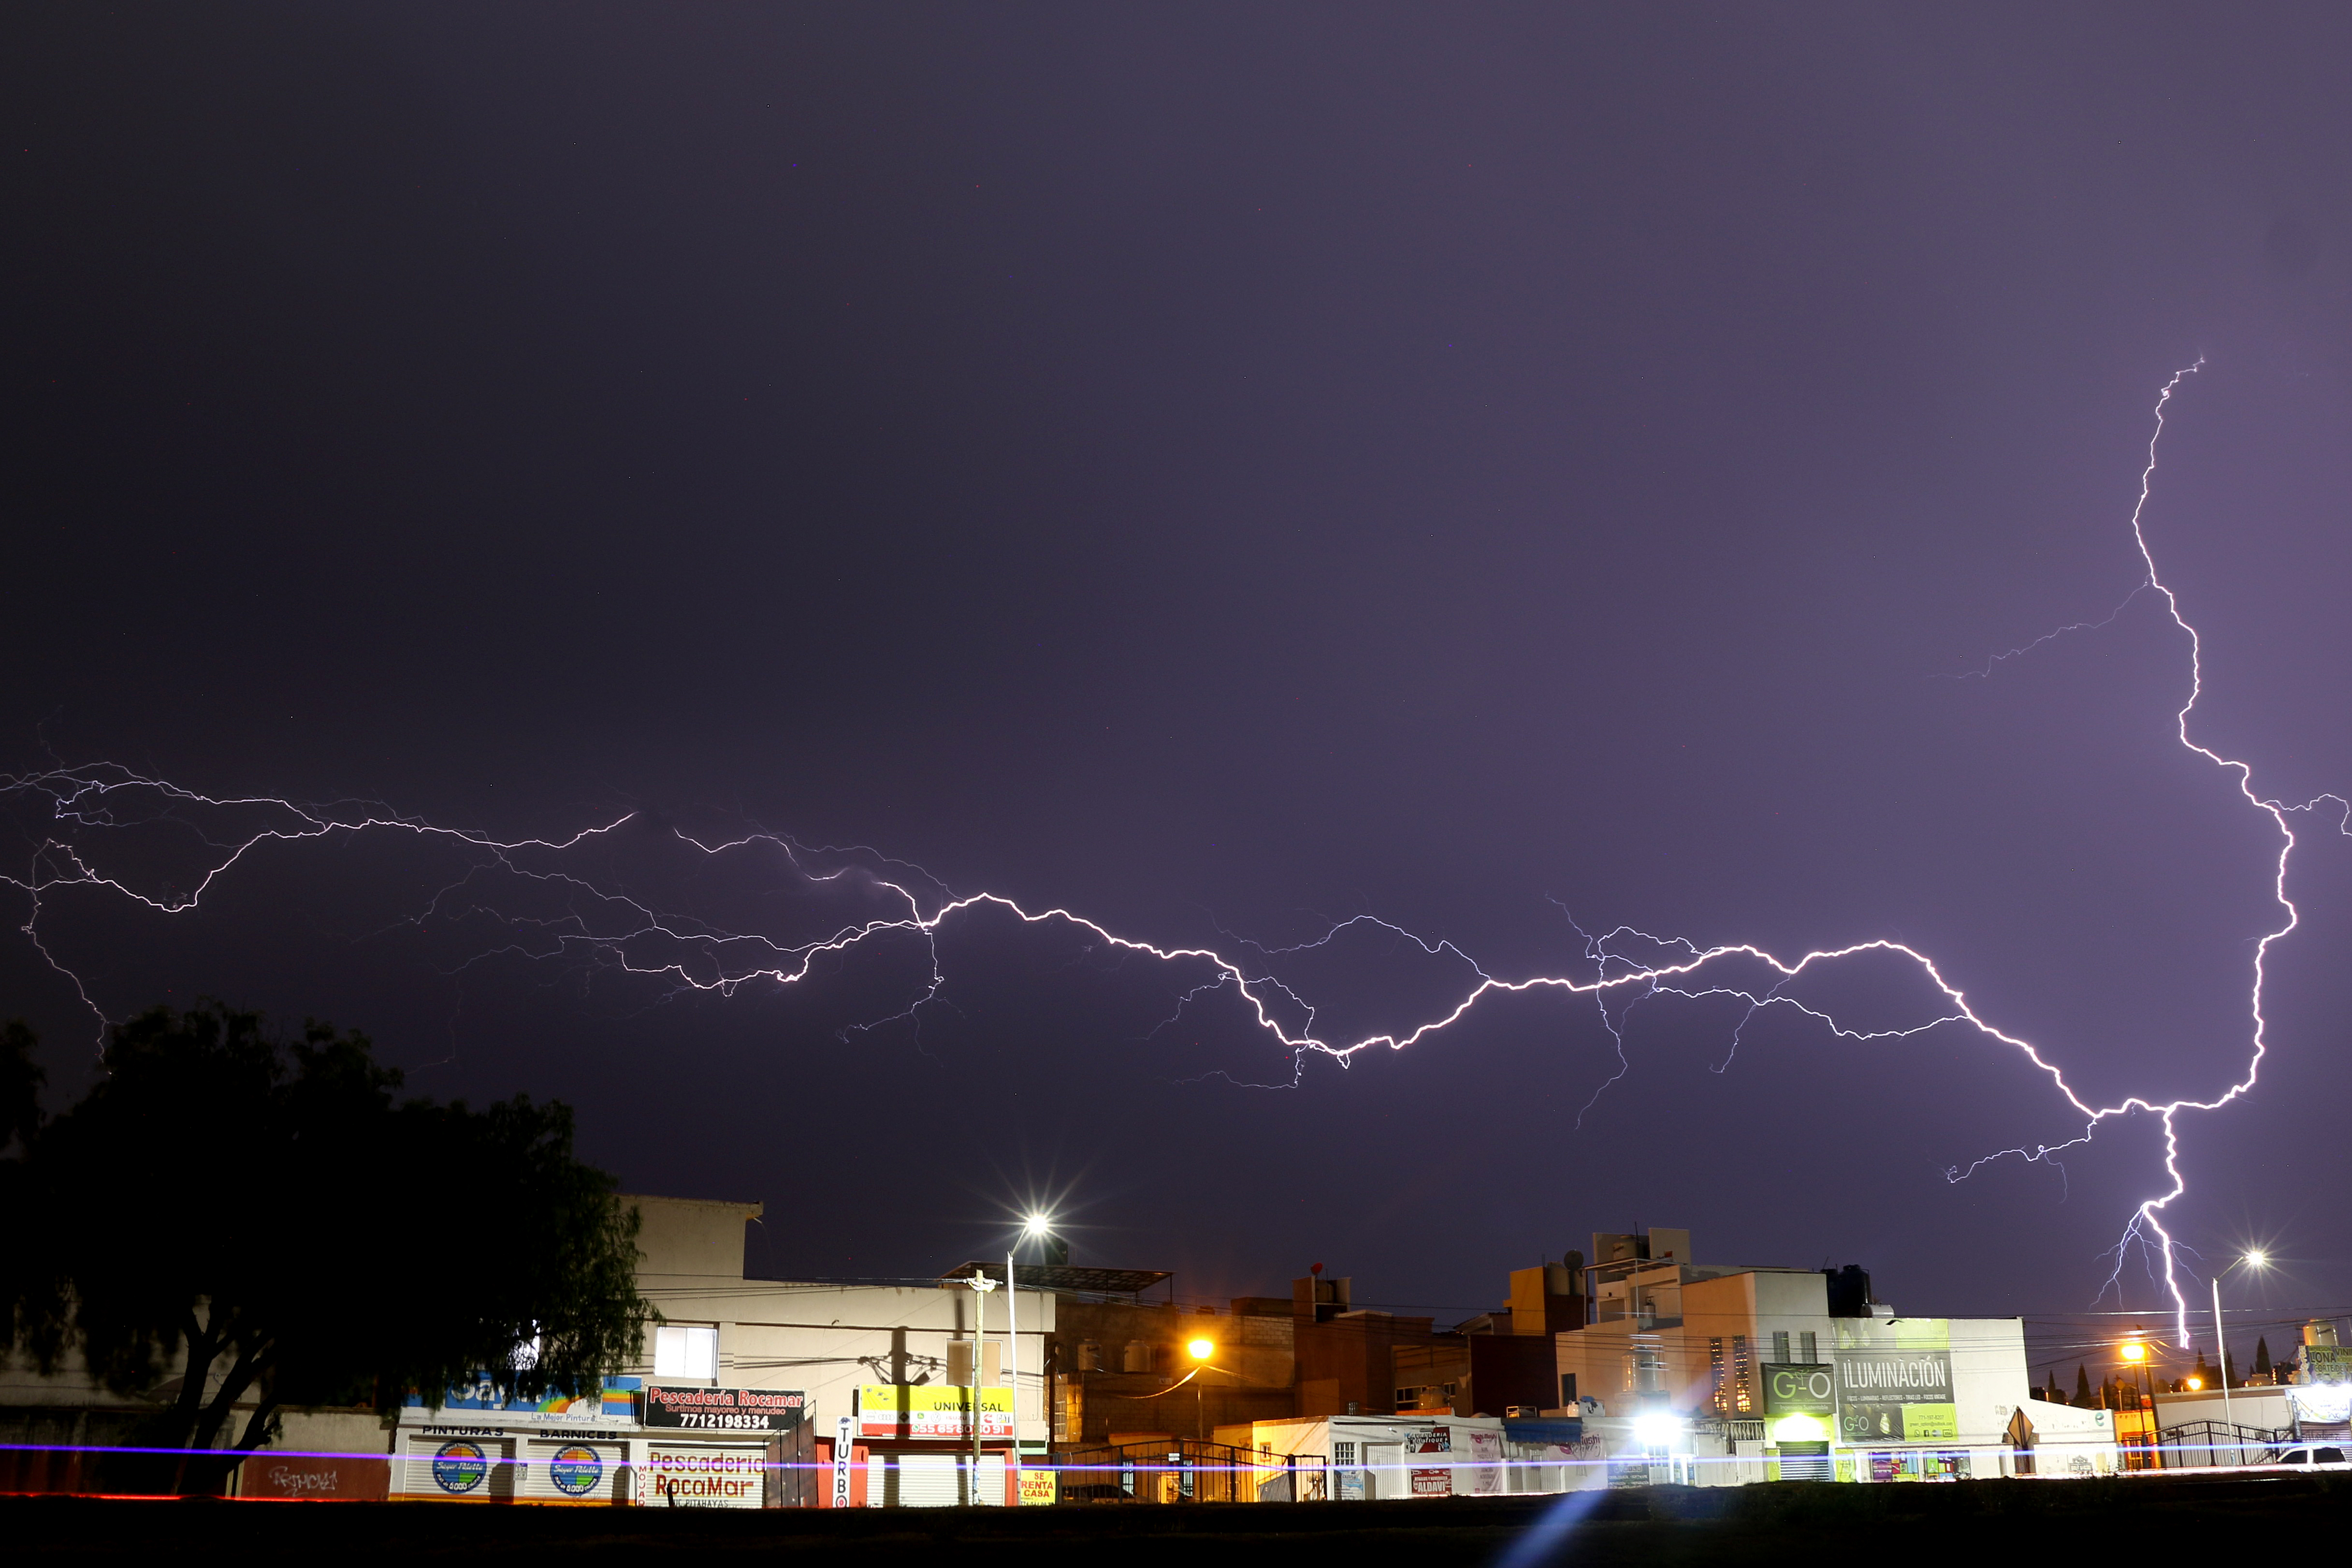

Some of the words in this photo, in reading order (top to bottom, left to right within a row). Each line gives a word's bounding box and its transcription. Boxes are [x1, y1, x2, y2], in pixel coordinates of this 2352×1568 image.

[2309, 1351, 2337, 1363] LONA
[1843, 1355, 1946, 1388] ILUMINACIÓN
[650, 1387, 734, 1406] Pescadería
[739, 1389, 803, 1408] Rocamar
[665, 1404, 703, 1413] Surtimos
[704, 1406, 740, 1415] mayoreo
[741, 1407, 747, 1415] y
[748, 1406, 786, 1415] menudeo
[934, 1402, 1004, 1412] UNIVESAL
[531, 1412, 541, 1421] La
[543, 1413, 563, 1422] Mejor
[566, 1413, 596, 1423] Pintura
[680, 1413, 769, 1429] 7712198334
[997, 1414, 1010, 1423] CAT
[422, 1426, 504, 1437] PINTURAS
[540, 1429, 617, 1439] BARNICES
[919, 1424, 935, 1434] 55
[937, 1424, 954, 1434] 65
[956, 1424, 973, 1434] 80
[992, 1425, 1005, 1434] 91
[1407, 1432, 1447, 1440] LAVANDERIA
[436, 1461, 457, 1471] Sayer
[650, 1452, 766, 1474] Pescaderia
[836, 1427, 849, 1508] TURBO
[553, 1465, 574, 1475] Sayer
[1034, 1472, 1045, 1481] SE
[655, 1474, 754, 1496] RocaMar
[1020, 1481, 1054, 1489] RENTA
[1023, 1489, 1050, 1497] CASA
